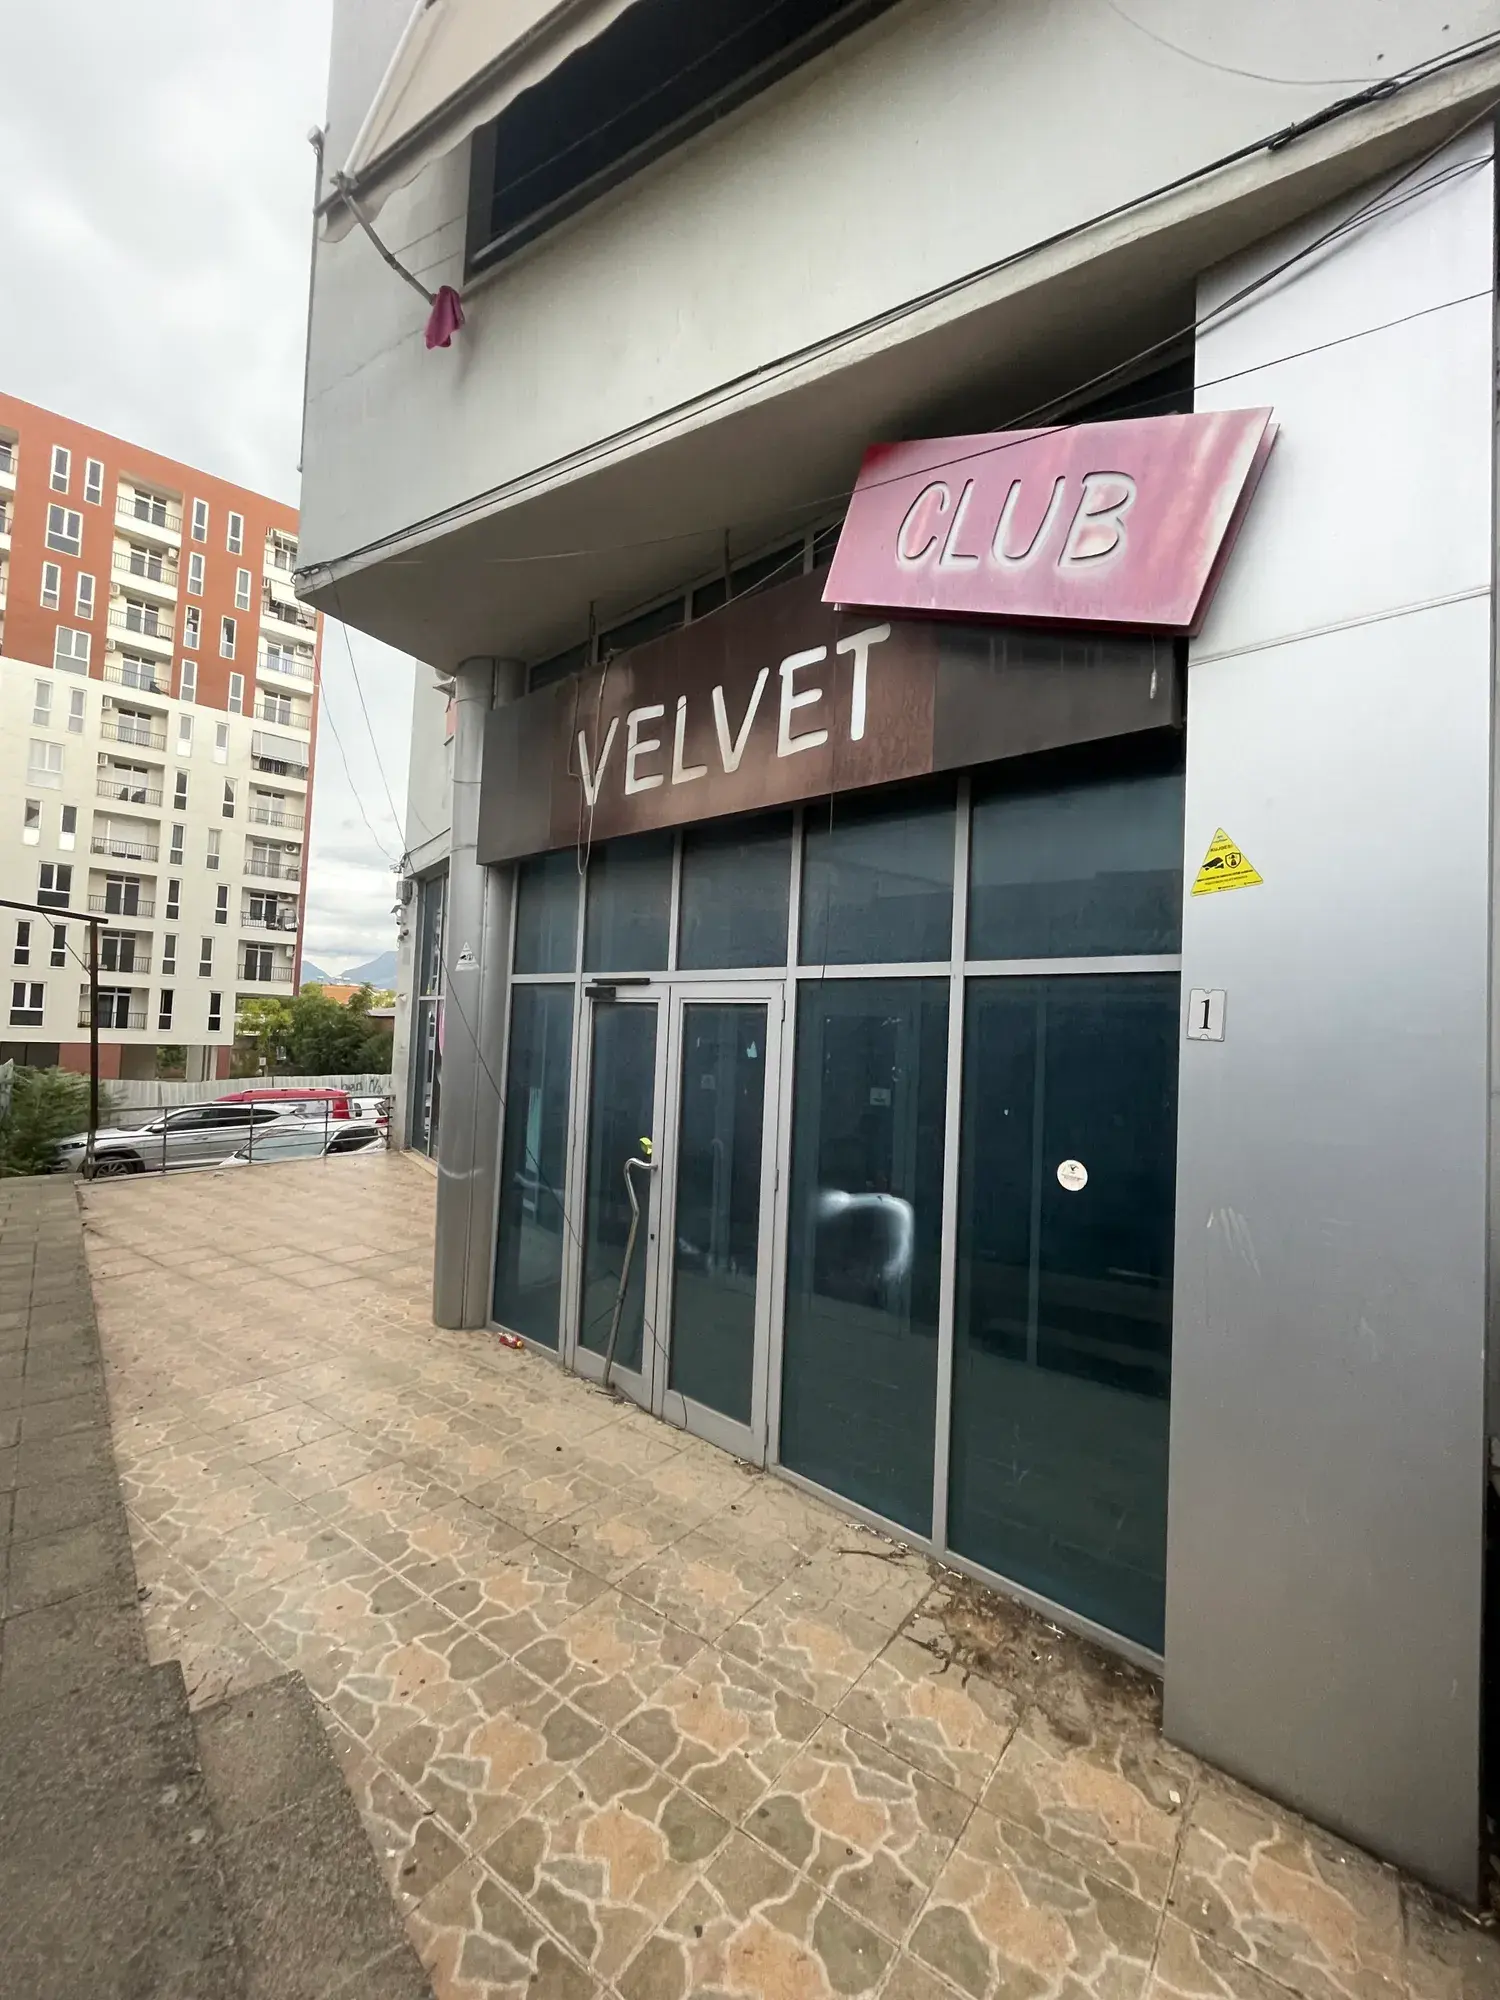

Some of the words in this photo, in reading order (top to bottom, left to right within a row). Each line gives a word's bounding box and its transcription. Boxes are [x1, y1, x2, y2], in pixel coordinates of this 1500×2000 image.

[896, 471, 1136, 569] CLUB
[578, 622, 891, 806] VELVET
[1199, 998, 1211, 1030] 1
